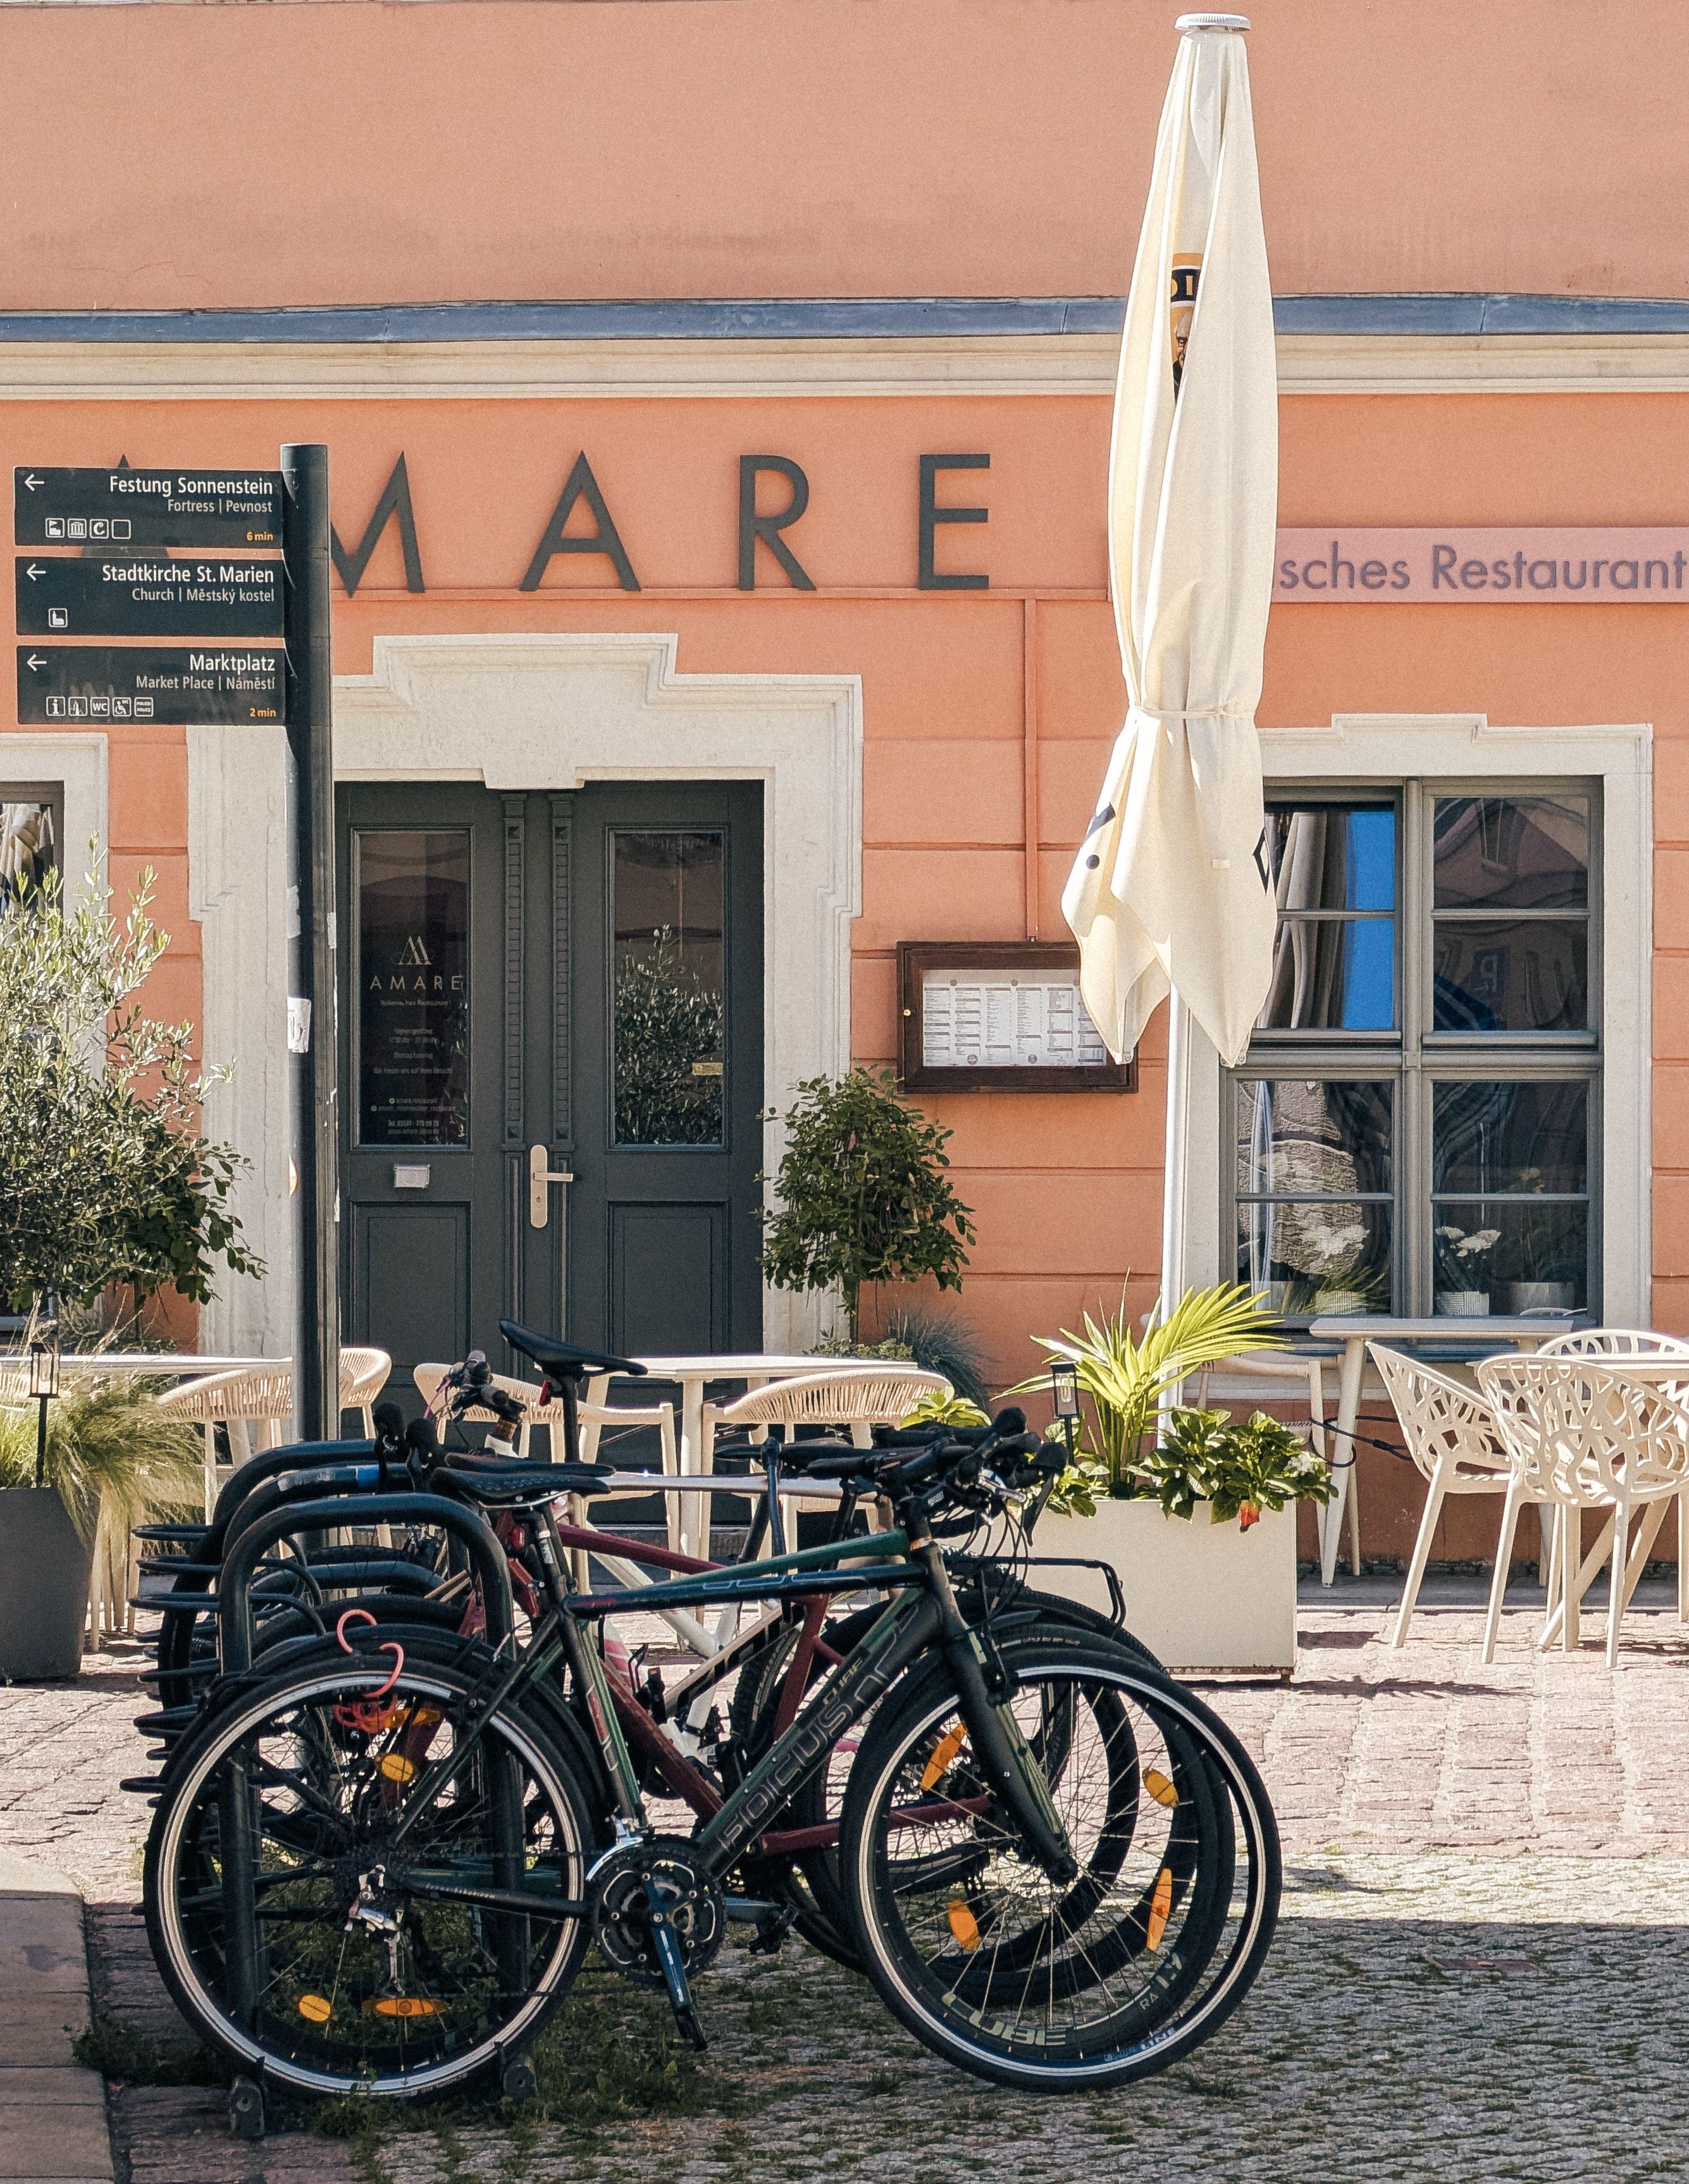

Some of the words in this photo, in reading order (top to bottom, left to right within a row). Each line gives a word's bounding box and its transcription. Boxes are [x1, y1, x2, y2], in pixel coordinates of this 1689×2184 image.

[110, 476, 171, 497] Festung
[178, 477, 273, 495] Sonnenstein
[168, 499, 215, 512] Fortress
[226, 500, 273, 513] Pevnost
[82, 452, 991, 598] MARE
[246, 531, 253, 541] 6
[254, 531, 274, 541] min
[102, 564, 191, 583] Stadtkirche
[197, 566, 216, 583] St.
[220, 566, 274, 583] Marien
[1272, 540, 1411, 589] sches
[1432, 544, 1687, 589] Restaurant
[132, 588, 174, 601] Church
[187, 587, 236, 605] Městský
[239, 588, 275, 602] kostel
[190, 653, 275, 674] Marktplatz
[136, 675, 179, 689] Market
[183, 676, 214, 689] Place
[226, 674, 275, 690] Náměstí
[92, 701, 108, 712] WC
[249, 707, 256, 717] 2
[257, 707, 276, 717] min
[369, 975, 461, 990] AMARE
[716, 1696, 854, 1853] FOCUS
[941, 1991, 1067, 2045] CUBE
